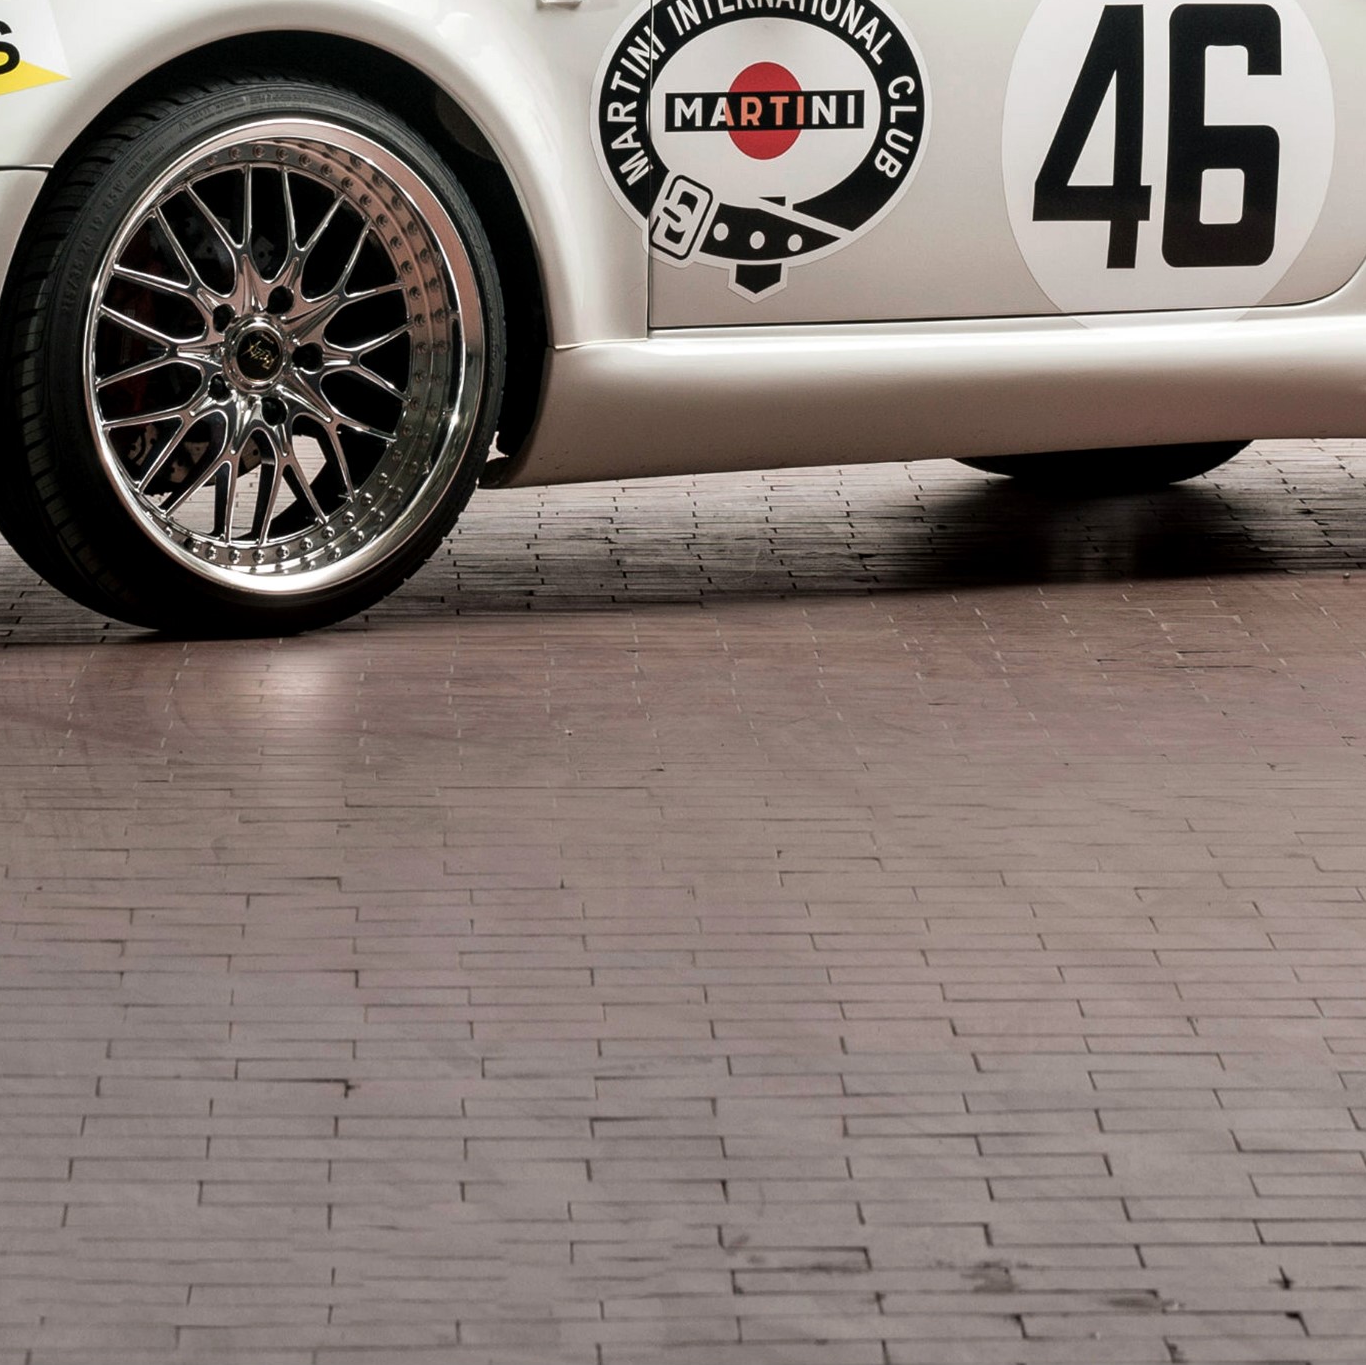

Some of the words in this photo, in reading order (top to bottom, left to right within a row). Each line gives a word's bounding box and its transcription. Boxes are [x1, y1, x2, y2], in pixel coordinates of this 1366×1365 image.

[607, 26, 667, 185] MARTINI
[874, 76, 917, 178] CLUB
[674, 94, 856, 127] MARTINI
[1032, 3, 1283, 269] 46
